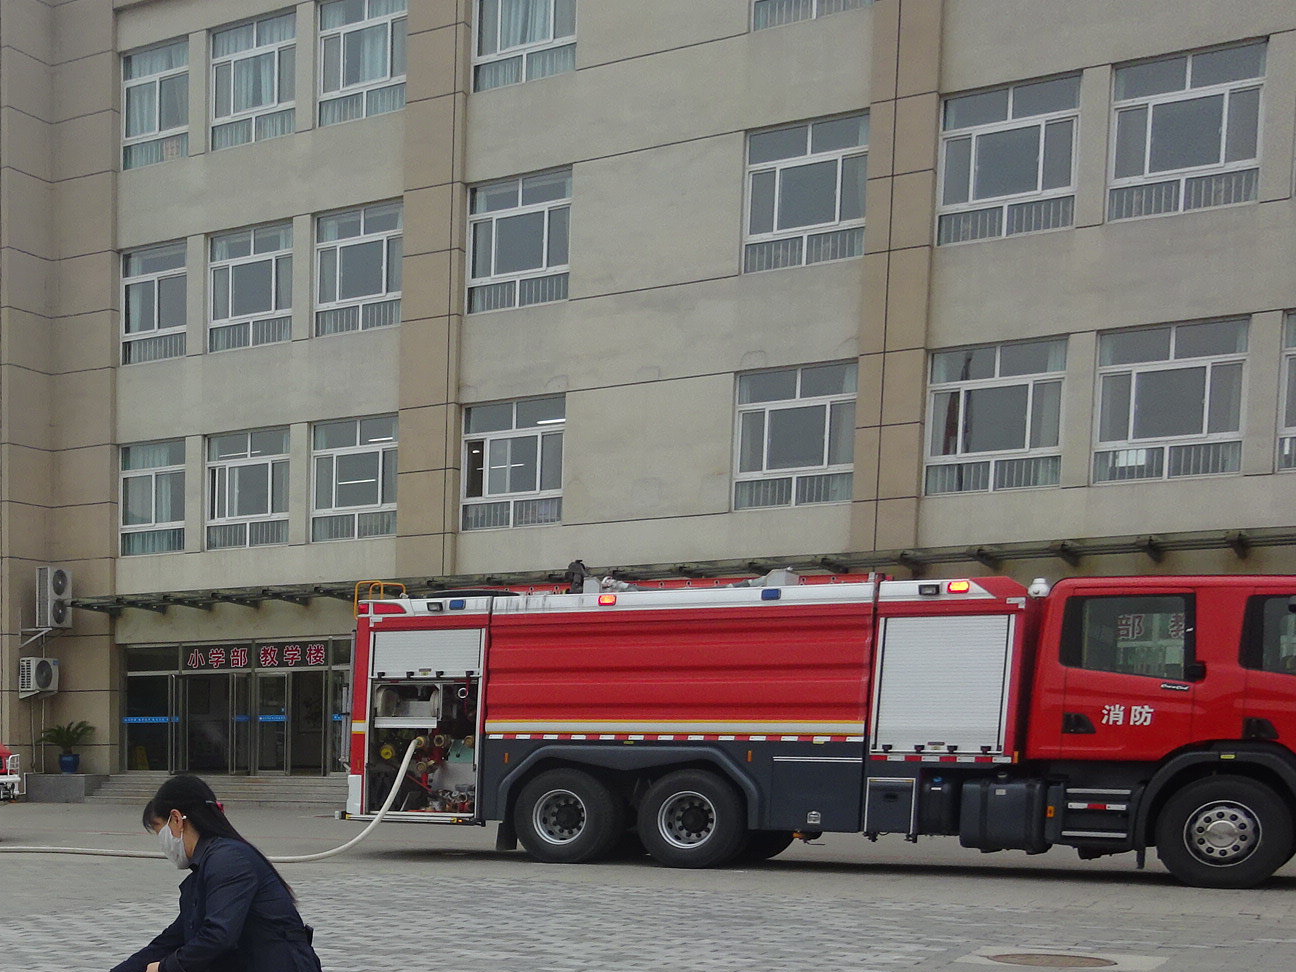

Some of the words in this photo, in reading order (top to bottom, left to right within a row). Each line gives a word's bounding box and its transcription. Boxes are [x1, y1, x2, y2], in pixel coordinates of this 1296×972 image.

[188, 648, 248, 668] 小学部
[260, 644, 325, 666] 教学楼
[1101, 704, 1154, 726] 消防
